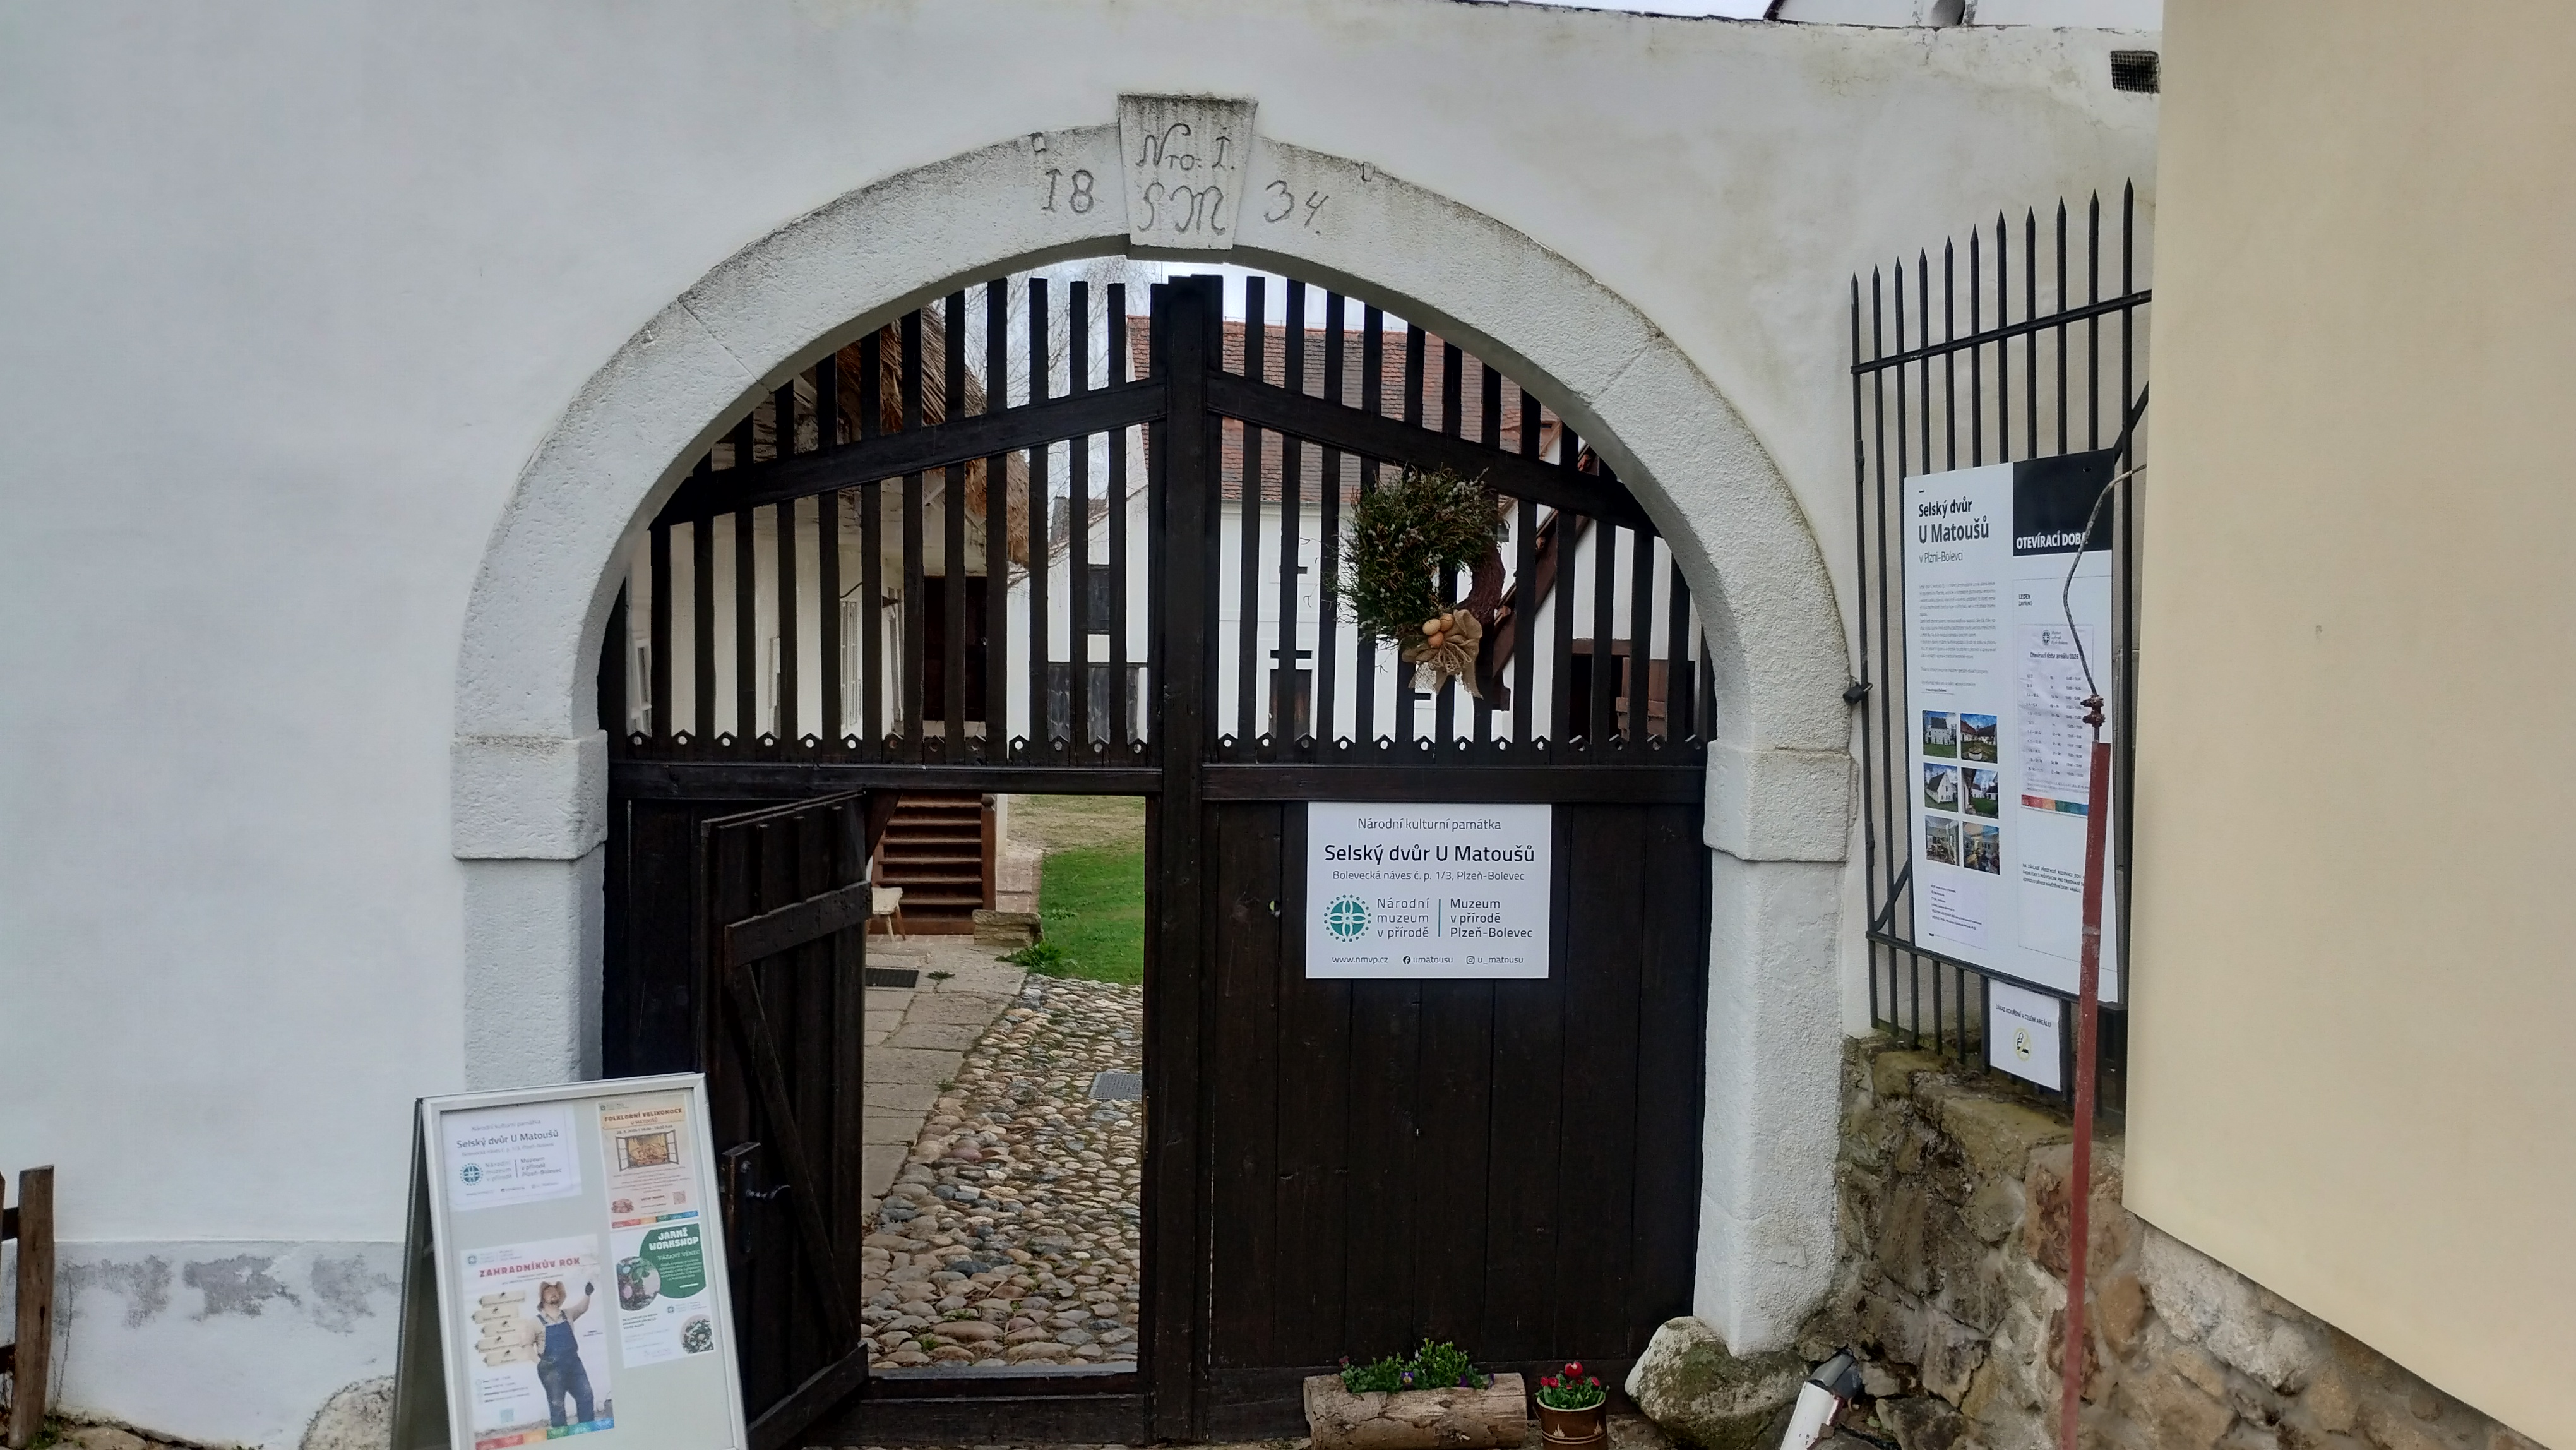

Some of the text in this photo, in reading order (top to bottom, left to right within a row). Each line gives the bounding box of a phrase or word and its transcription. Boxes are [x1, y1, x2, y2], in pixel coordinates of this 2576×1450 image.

[1041, 168, 1095, 216] 18
[1919, 496, 1972, 519] Selský dvůr
[1919, 515, 1989, 544] U Matoušů
[2017, 530, 2061, 549] OTEVÍRACÍ
[1358, 818, 1501, 832] Národní kulturní památka
[1325, 844, 1534, 865] Selský dvůr U Matoušů
[1333, 871, 1524, 882] Bolevecká náves č. p. 1/3, Plzeň-Bolevec
[1378, 897, 1429, 908] Národní
[1451, 899, 1500, 908] Muzeum
[1460, 913, 1500, 925] přírodě
[1388, 927, 1429, 939] přírodě
[1451, 927, 1532, 937] Plzeň-Bolevec
[456, 1139, 486, 1148] Selský
[489, 1135, 508, 1145] dvůr
[520, 1129, 559, 1141] Matoušů
[658, 1227, 688, 1240] JARNÍ
[649, 1237, 699, 1250] WORKSHOP
[479, 1257, 580, 1278] ZAHRADNÍKŮV ROK
